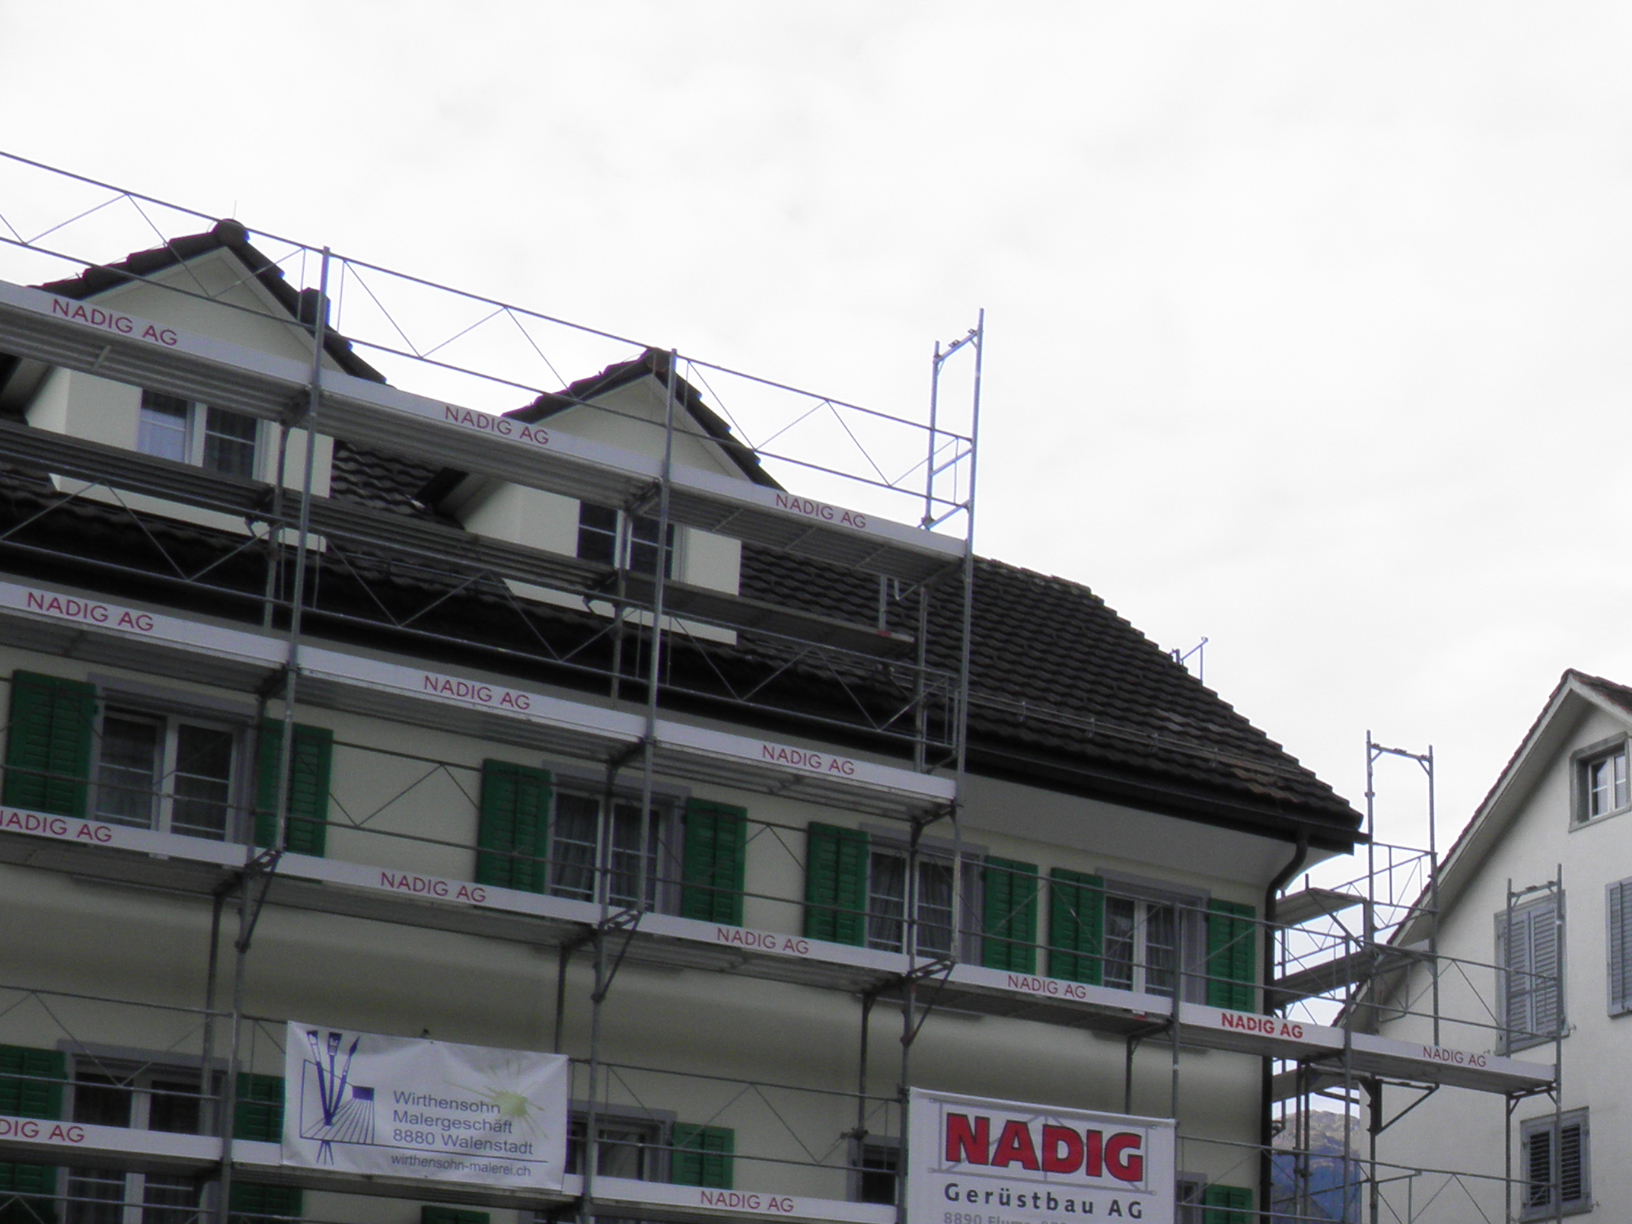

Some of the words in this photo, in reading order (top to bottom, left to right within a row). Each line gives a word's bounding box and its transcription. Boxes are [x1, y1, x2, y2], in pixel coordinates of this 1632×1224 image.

[51, 299, 133, 335] NADIG
[140, 324, 178, 347] AG
[445, 406, 512, 436] NADIG
[519, 426, 549, 445] AG
[774, 494, 834, 521] NADIG
[839, 508, 867, 529] AG
[26, 592, 109, 624] NADIG
[116, 611, 154, 632] AG
[423, 676, 493, 704] NADIG
[499, 692, 530, 711] AG
[761, 745, 822, 771] NADIG
[827, 759, 855, 776] AG
[0, 810, 68, 837] ADIG
[379, 872, 449, 898] NADIG
[455, 885, 487, 904] AG
[715, 927, 777, 950] NADIG
[782, 939, 809, 956] AG
[1006, 975, 1059, 996] NADIG
[1062, 984, 1087, 1000] AG
[1220, 1013, 1276, 1036] NADIG
[1279, 1023, 1303, 1040] AG
[1422, 1046, 1465, 1065] NADIG
[1468, 1054, 1488, 1068] AG
[393, 1090, 501, 1114] Wirthensohn
[393, 1110, 513, 1134] Malergeschäft
[393, 1128, 436, 1146] 8880
[441, 1133, 533, 1155] Walenstadt
[944, 1112, 1144, 1183] NADIG
[391, 1154, 531, 1177] wirthensohn-malerei.ch
[699, 1190, 762, 1212] NADIG
[766, 1197, 794, 1214] AG
[944, 1183, 1094, 1214] Gerüstbau
[1107, 1199, 1143, 1219] AG
